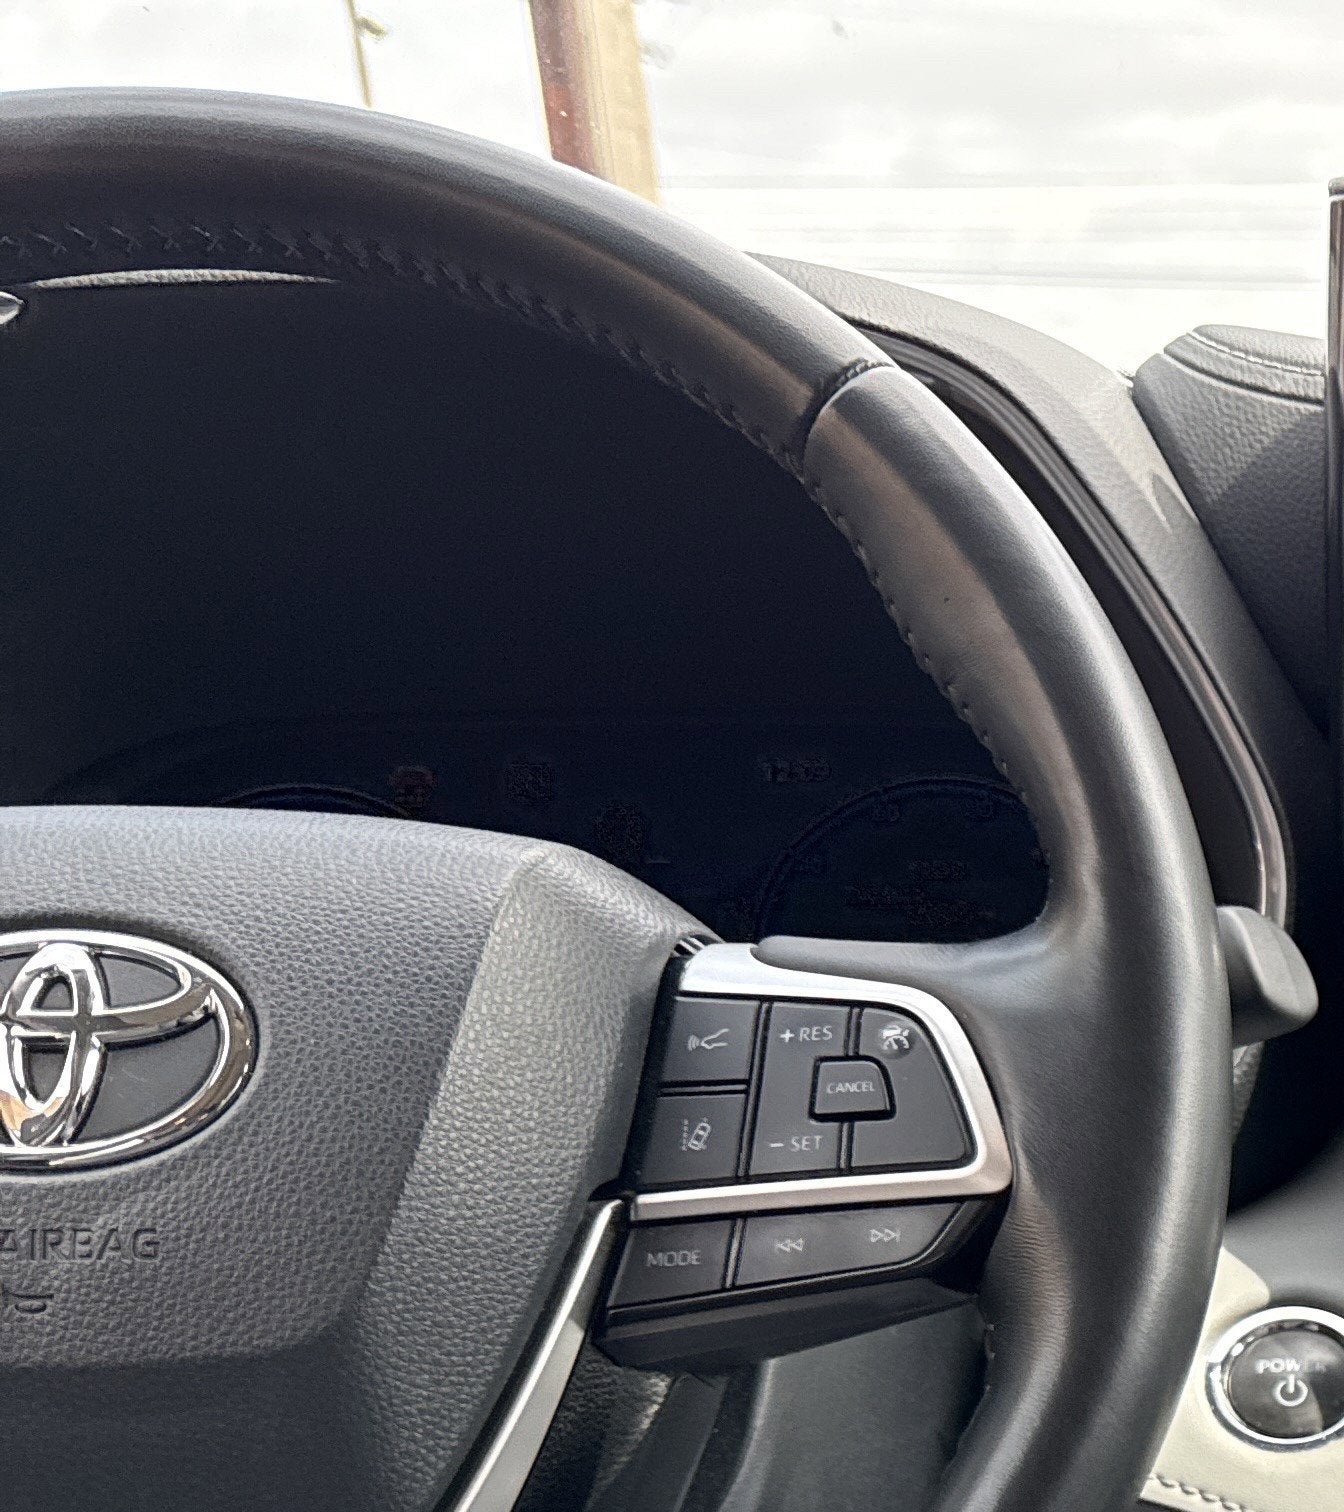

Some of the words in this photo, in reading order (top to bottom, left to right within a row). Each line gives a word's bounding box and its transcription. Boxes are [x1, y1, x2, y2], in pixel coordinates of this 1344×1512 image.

[798, 1024, 833, 1043] RES
[825, 1080, 876, 1095] CANCEL
[790, 1135, 824, 1152] SET
[646, 1250, 702, 1267] MODE
